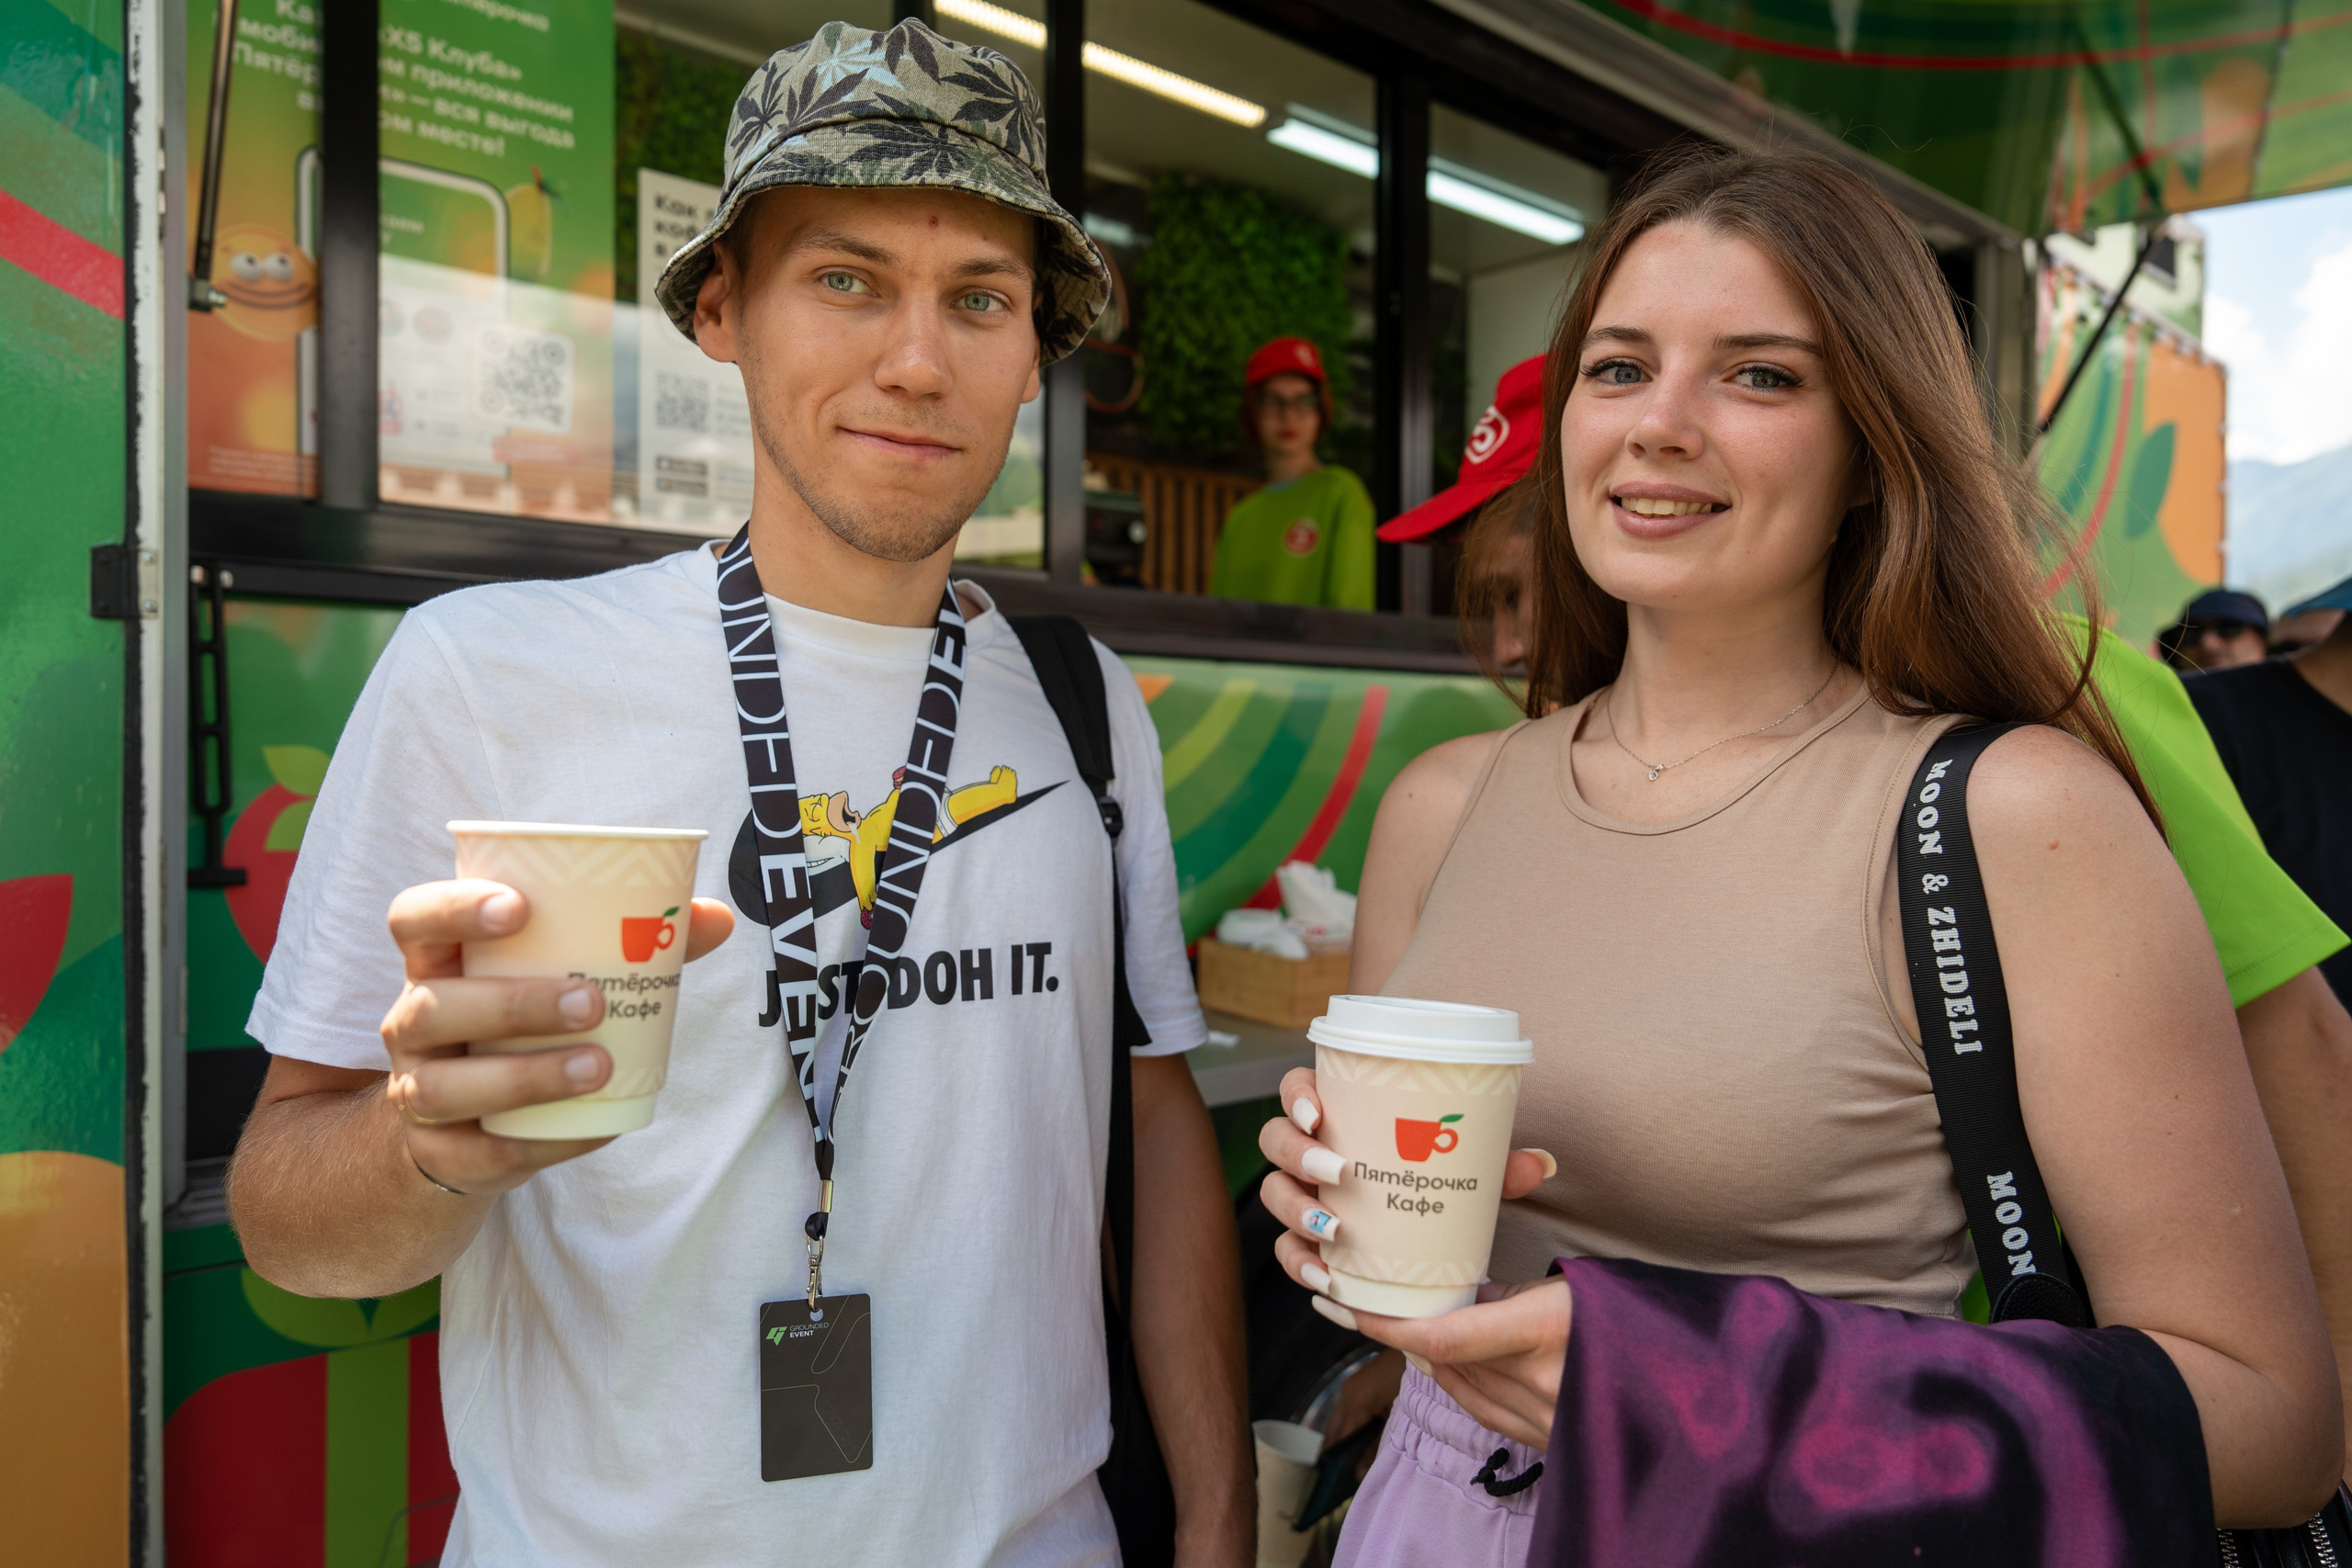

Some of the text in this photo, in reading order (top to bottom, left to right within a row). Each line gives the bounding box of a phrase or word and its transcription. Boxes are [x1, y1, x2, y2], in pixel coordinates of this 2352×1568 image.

[1917, 759, 1983, 1055] MOON & ZHIDELI
[759, 942, 1059, 1028] JST DOH IT.
[608, 998, 662, 1021] Кафе
[1354, 1161, 1478, 1191] Пятёрочка
[1386, 1192, 1444, 1216] Кафе
[1986, 1170, 2037, 1276] MOON
[789, 1322, 830, 1332] GROUNDED
[789, 1329, 814, 1338] EVENT
